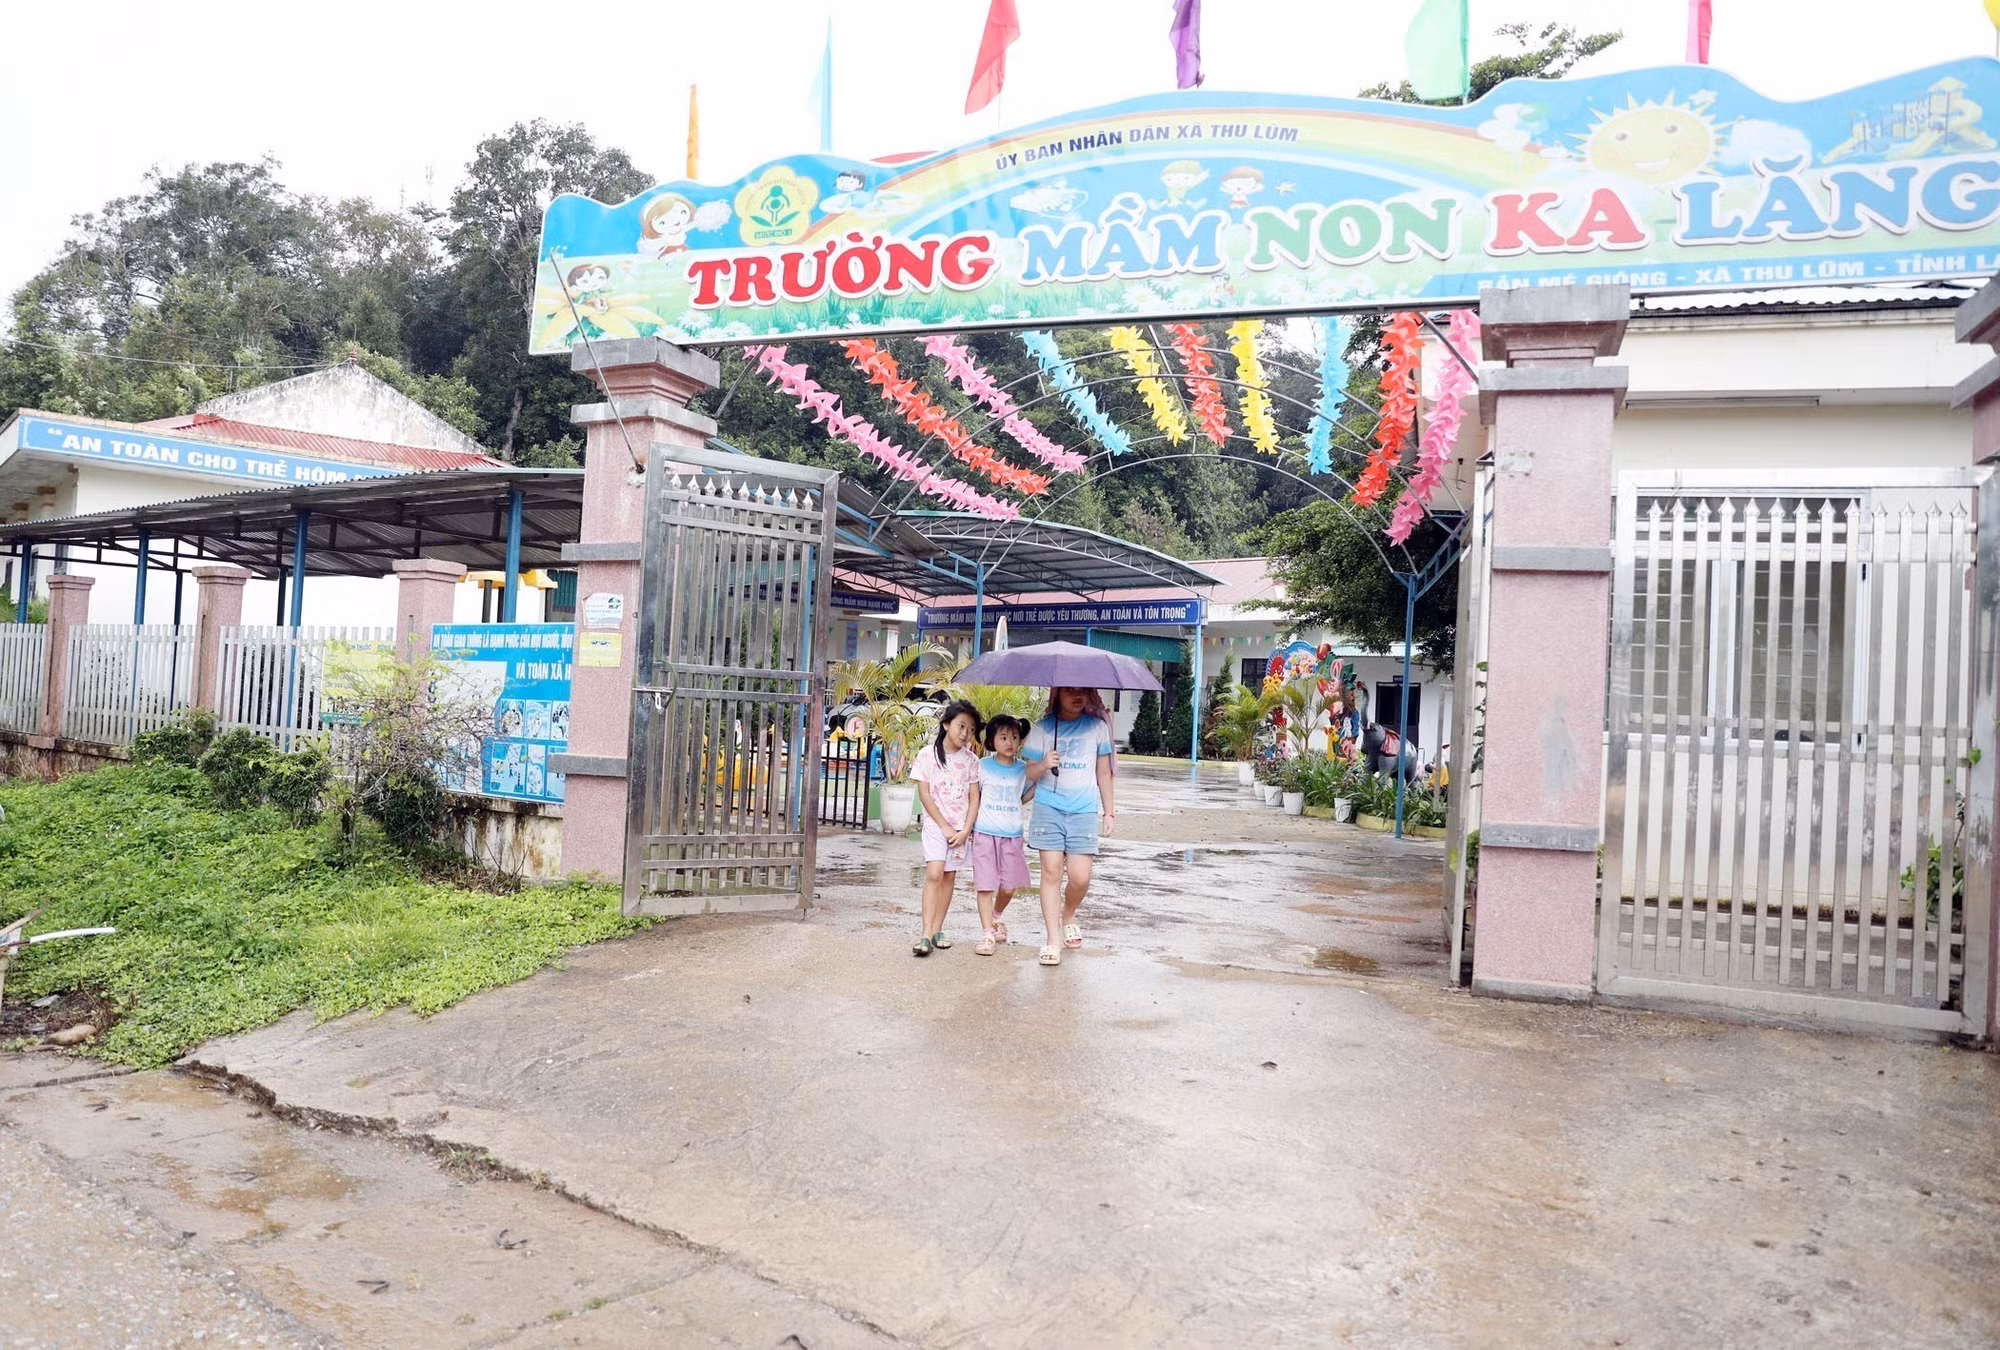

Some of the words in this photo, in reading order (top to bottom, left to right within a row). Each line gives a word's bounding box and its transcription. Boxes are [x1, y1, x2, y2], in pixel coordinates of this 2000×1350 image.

[1024, 142, 1063, 162] BAN
[1069, 130, 1122, 152] NHÂN
[1129, 124, 1170, 143] DÂN
[1176, 122, 1203, 139] XÃ
[1210, 124, 1248, 138] THU
[1253, 123, 1299, 142] LŨM
[687, 231, 995, 305] TRƯỜNG
[1022, 197, 1221, 280] MẦM
[1250, 199, 1456, 265] NON
[1490, 188, 1646, 249] KA
[1681, 160, 2000, 240] LĂNG
[1696, 266, 1732, 284] XÃ
[1740, 265, 1793, 281] THU
[110, 441, 179, 464] TOÀN
[187, 451, 238, 472] CHO
[245, 459, 288, 478] TRẺ
[295, 465, 347, 482] HÔM
[1057, 608, 1070, 621] YÊU
[1101, 609, 1111, 621] AN
[1112, 608, 1131, 621] TOÀN
[1133, 607, 1143, 620] VÀ
[1144, 606, 1159, 619] TÔN
[516, 659, 525, 679] VÀ
[527, 659, 549, 679] TOÀN
